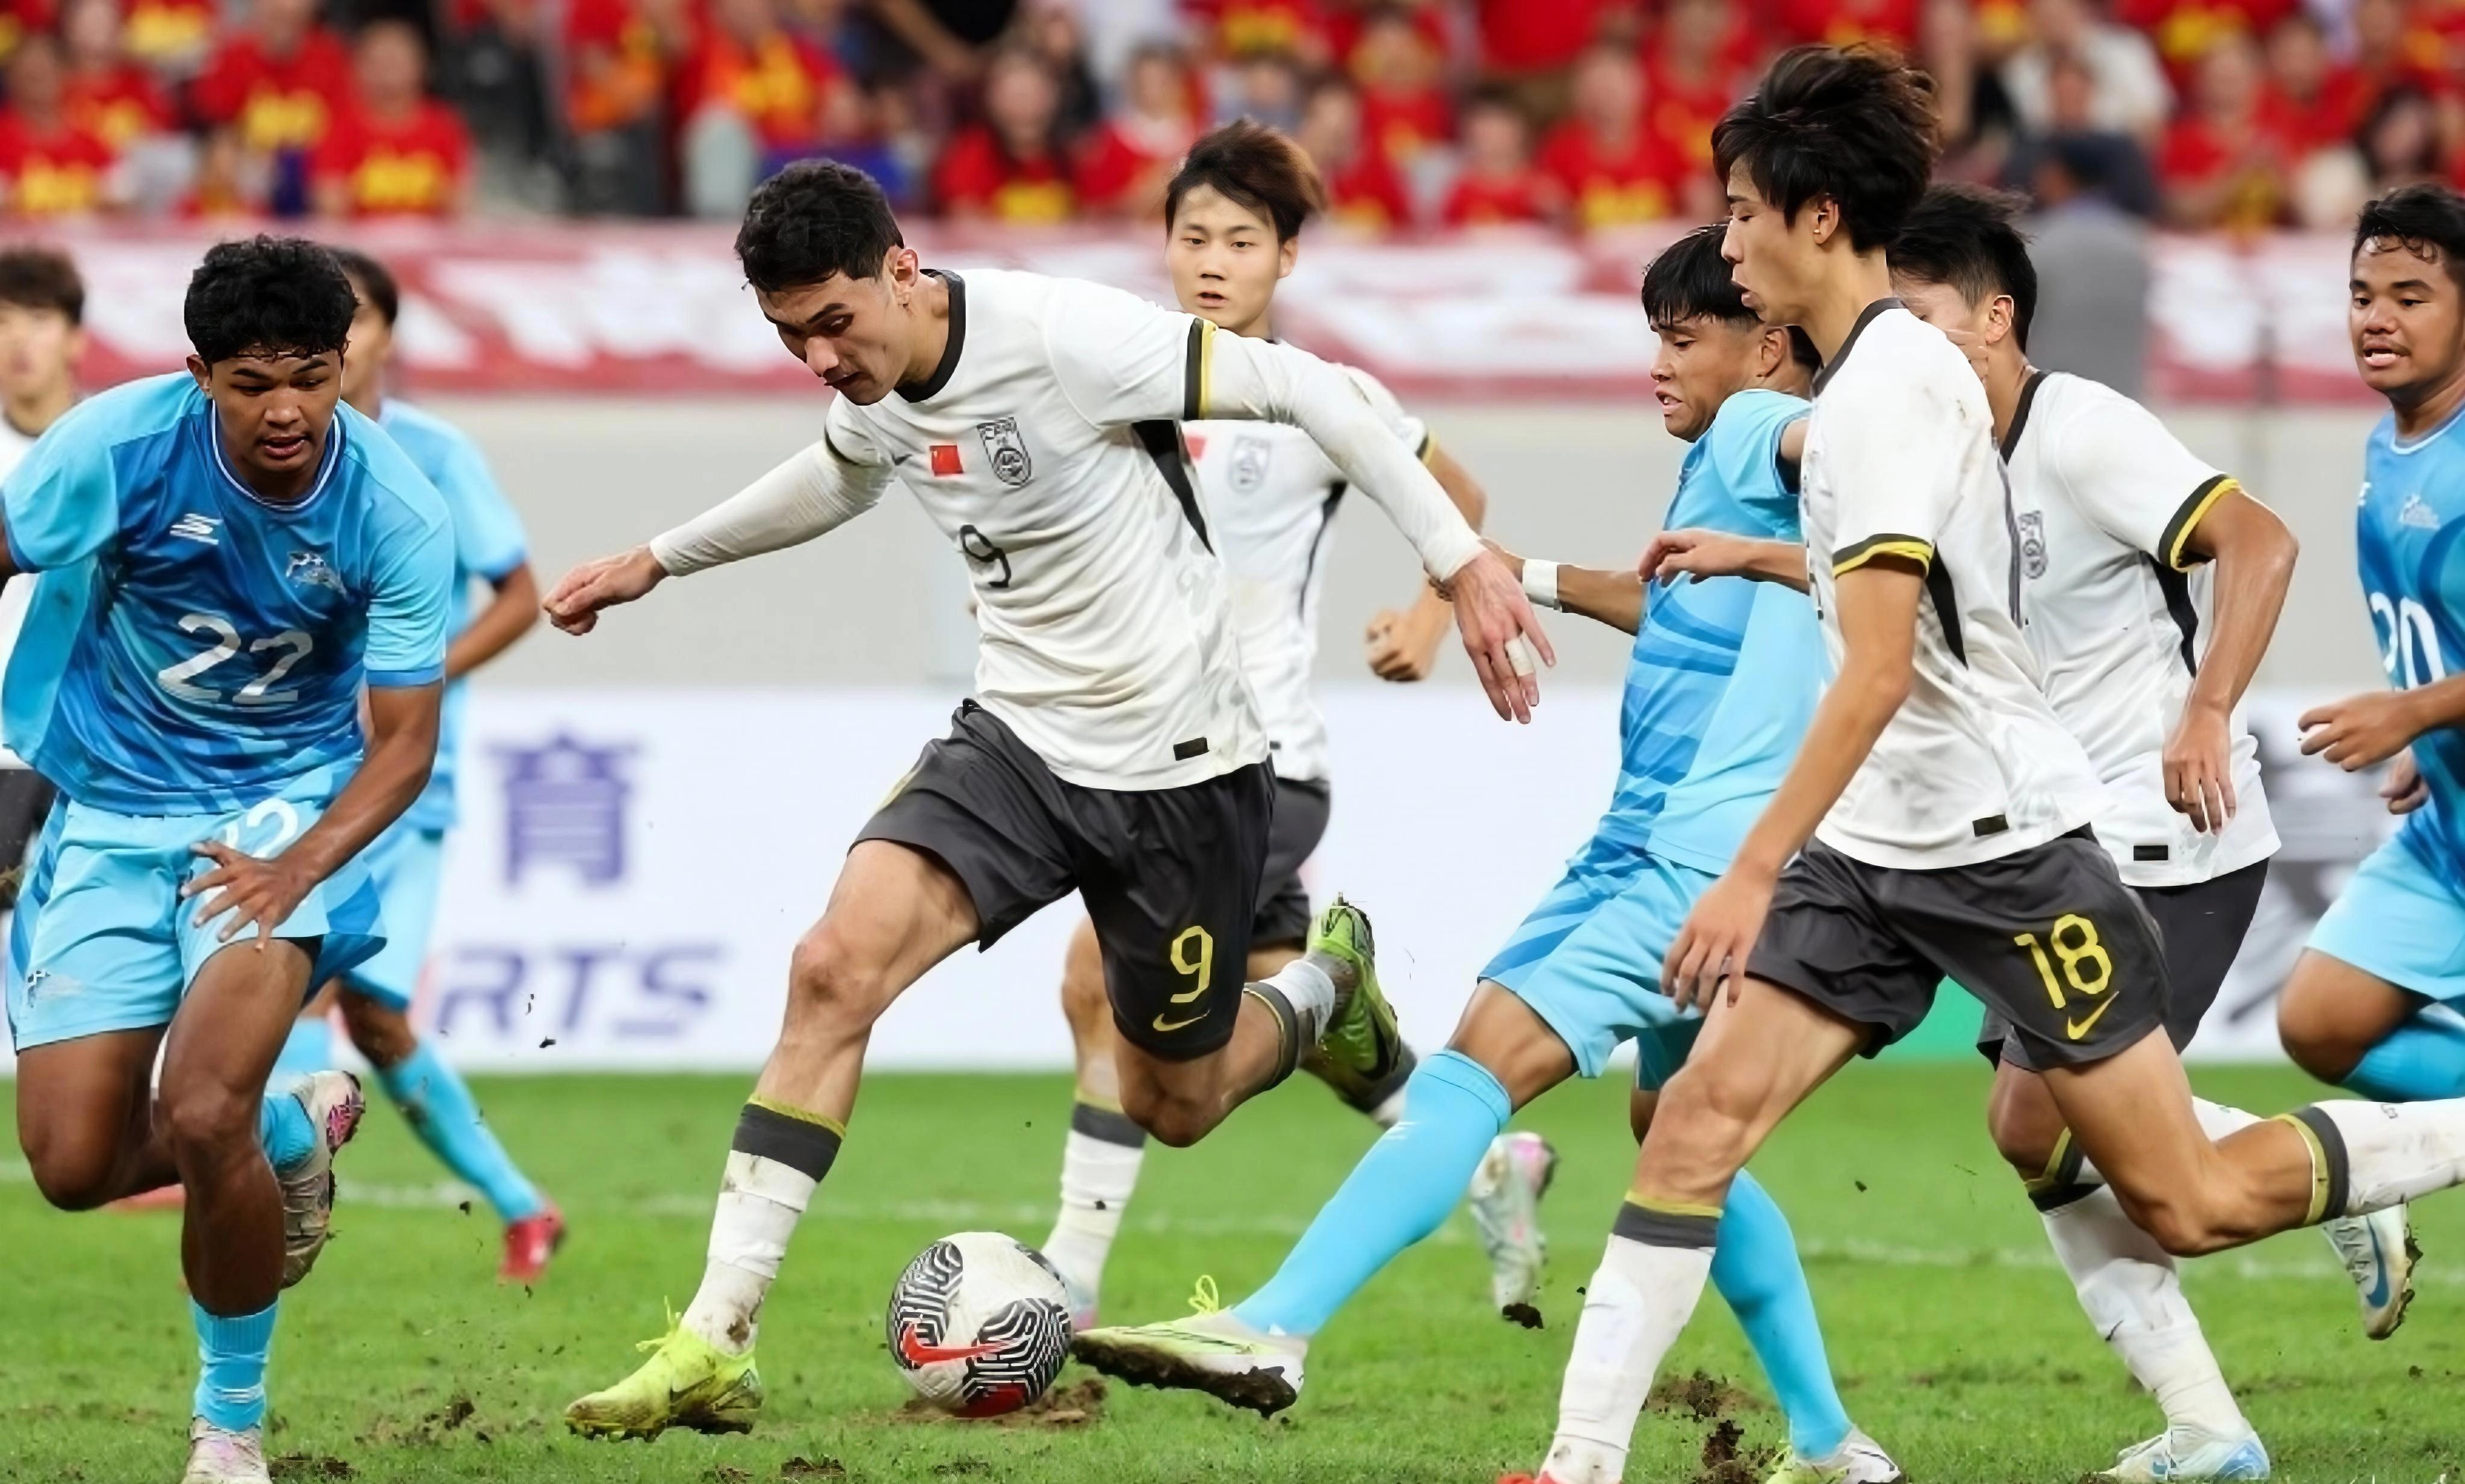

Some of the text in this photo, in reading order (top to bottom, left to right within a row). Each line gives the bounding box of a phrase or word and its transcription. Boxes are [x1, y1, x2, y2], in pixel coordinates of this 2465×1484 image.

[959, 524, 1012, 589] 9
[157, 614, 313, 705] 22
[2370, 592, 2446, 692] 20
[483, 727, 643, 891] 育
[1170, 925, 1213, 1003] 9
[2014, 914, 2112, 1009] 18
